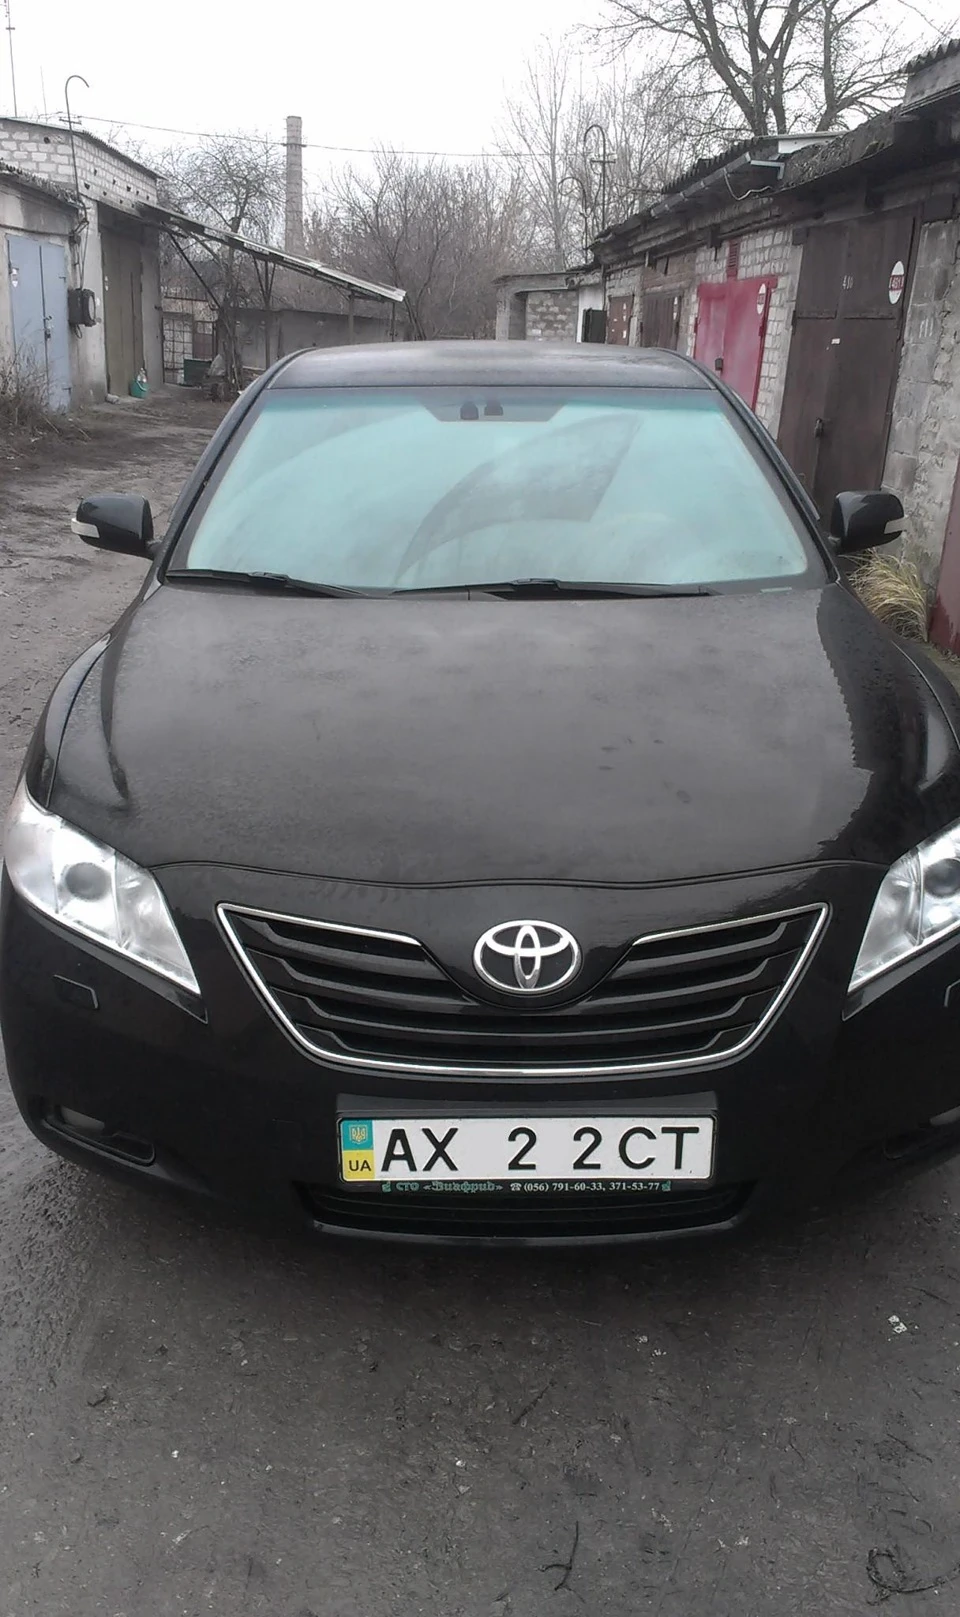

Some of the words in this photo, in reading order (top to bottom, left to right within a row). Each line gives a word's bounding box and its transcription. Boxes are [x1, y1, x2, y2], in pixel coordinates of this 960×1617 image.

[381, 1128, 459, 1172] AX
[349, 1160, 371, 1172] UA
[523, 1182, 550, 1192] (056)
[552, 1181, 606, 1192] 791-60-33,
[609, 1181, 660, 1191] 371-53-77
